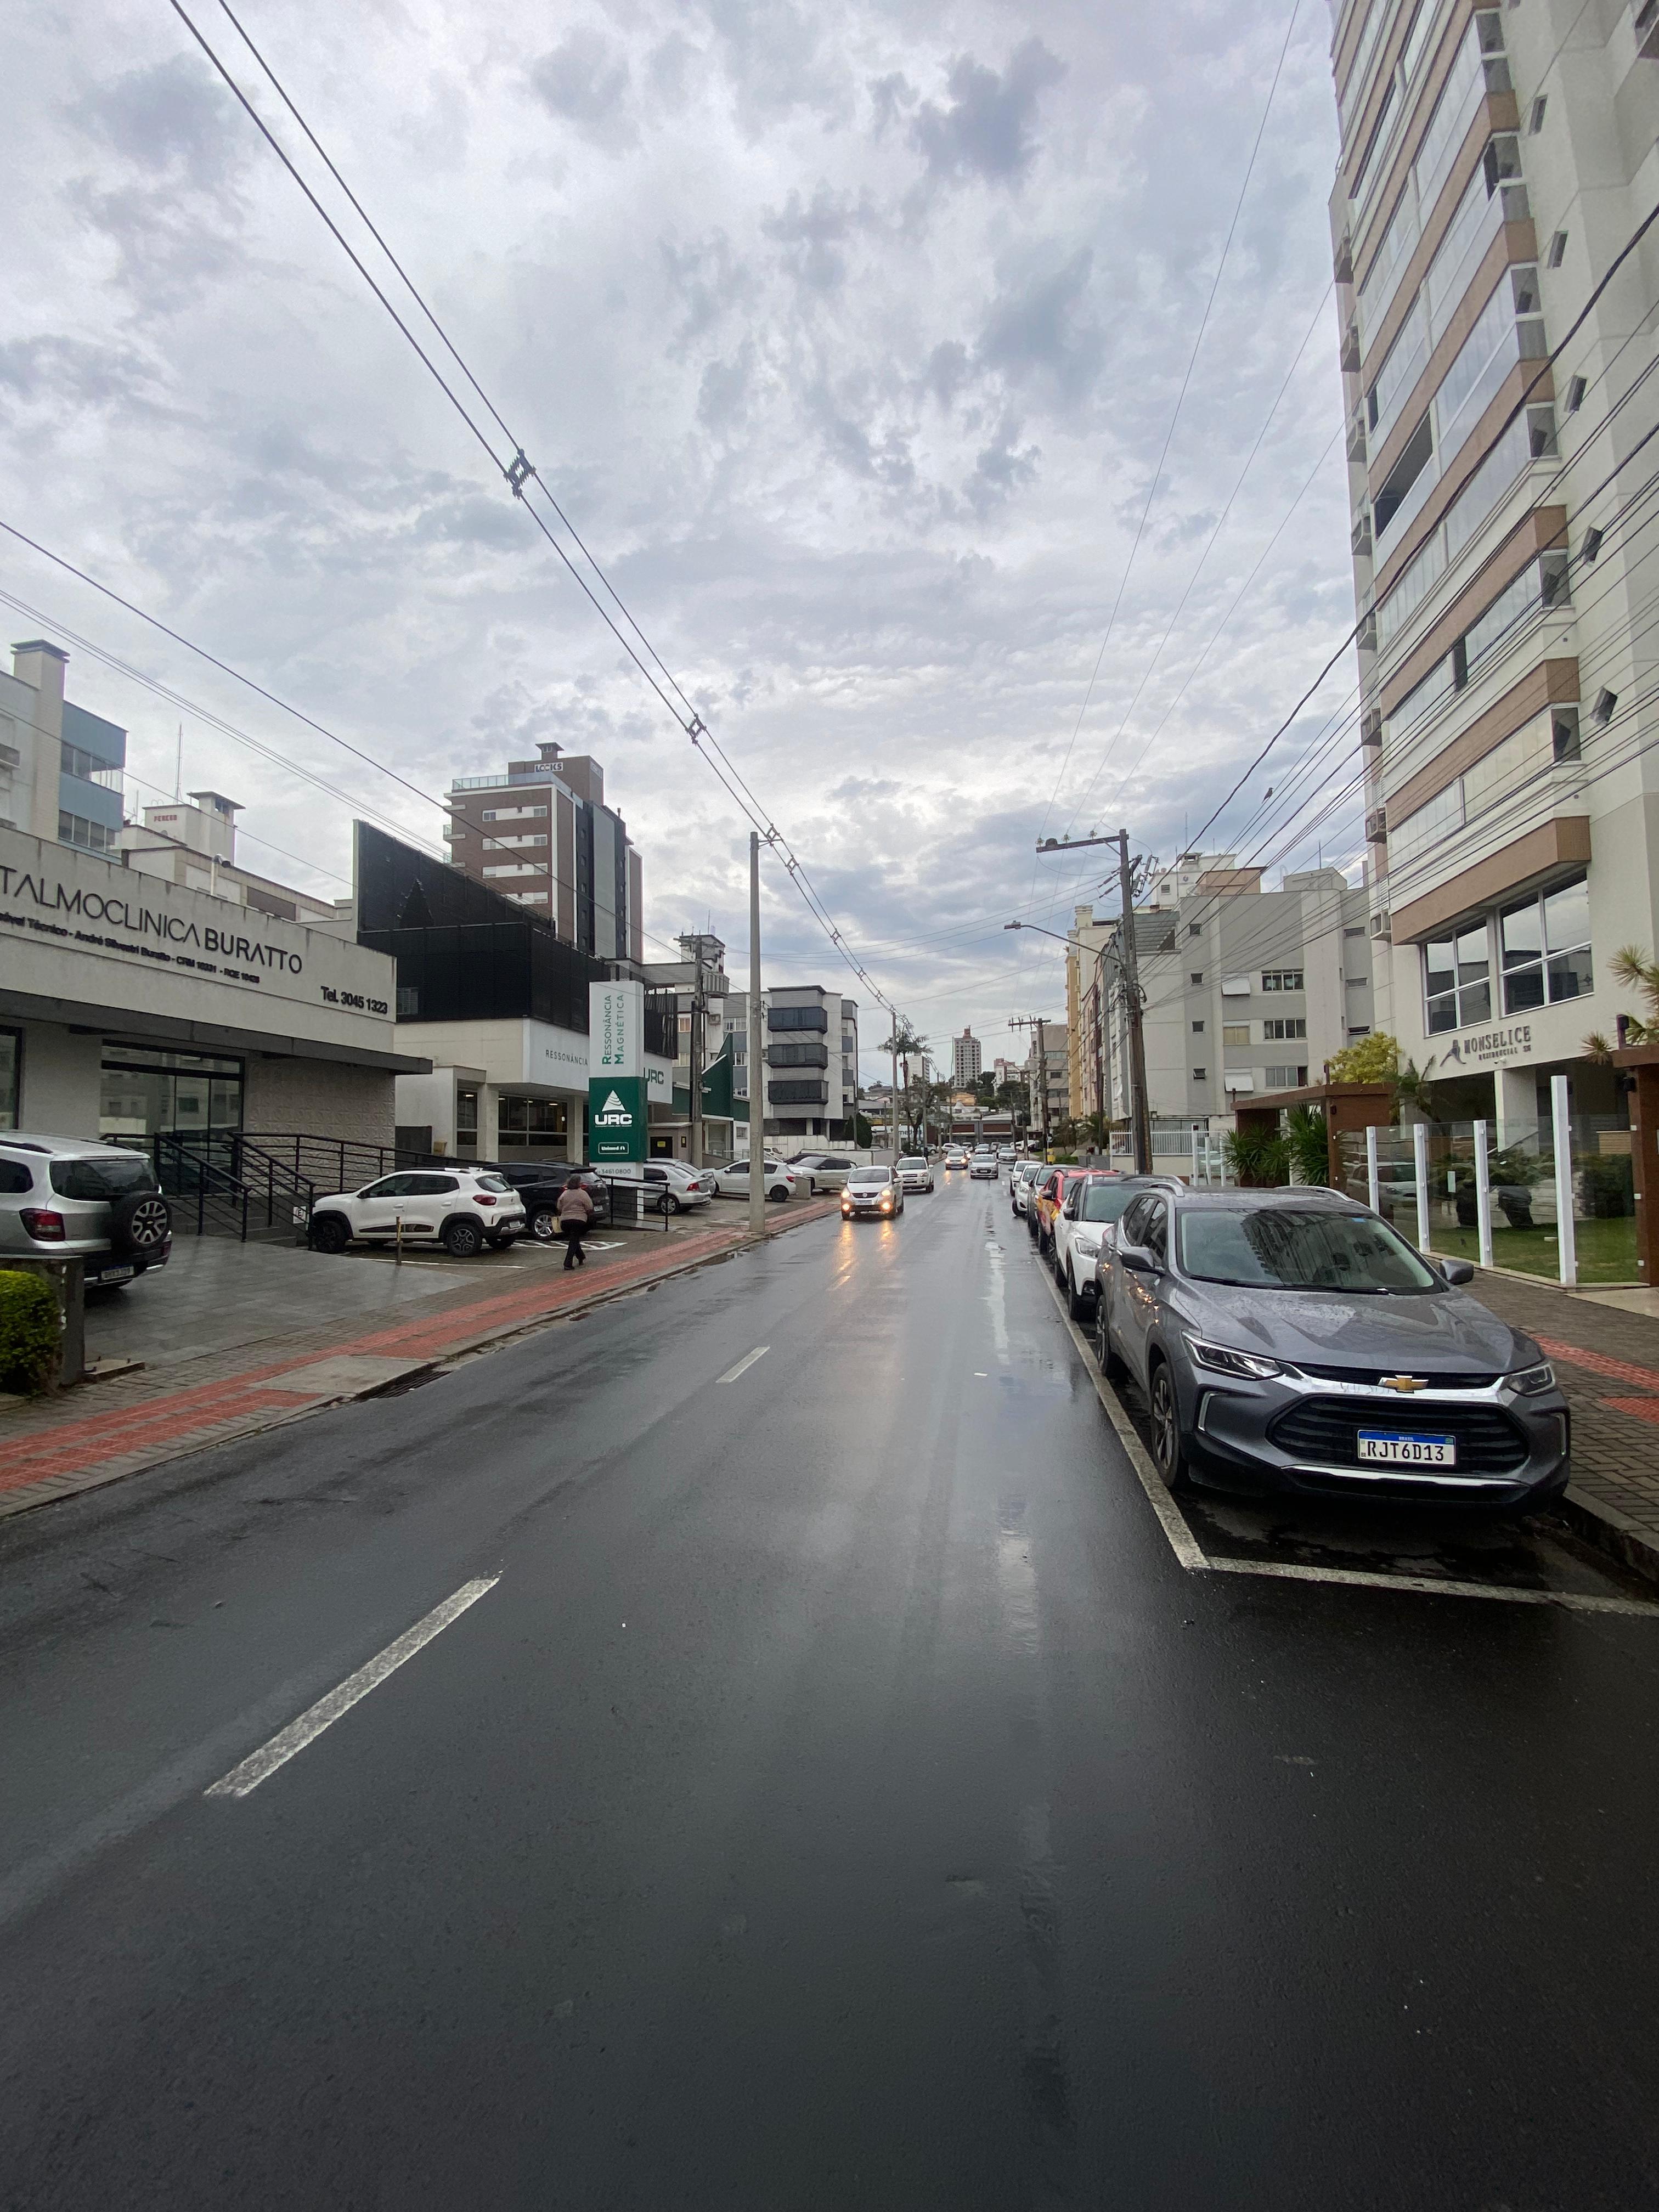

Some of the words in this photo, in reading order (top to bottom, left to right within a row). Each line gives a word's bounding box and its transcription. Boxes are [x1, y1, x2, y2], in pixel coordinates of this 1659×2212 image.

[205, 927, 302, 974] BURATTO
[320, 985, 338, 1003] Tel.
[341, 991, 364, 1008] 3045
[366, 998, 387, 1014] 1323
[602, 995, 612, 1065] RESSONÂNCIA
[614, 994, 624, 1065] MAGNÉTICA
[1464, 1025, 1531, 1054] MONSELICE
[545, 1049, 588, 1066] RESSONÂNCIA
[644, 1067, 664, 1085] URC
[595, 1114, 633, 1125] URC
[1368, 1441, 1444, 1461] RJT6D13
